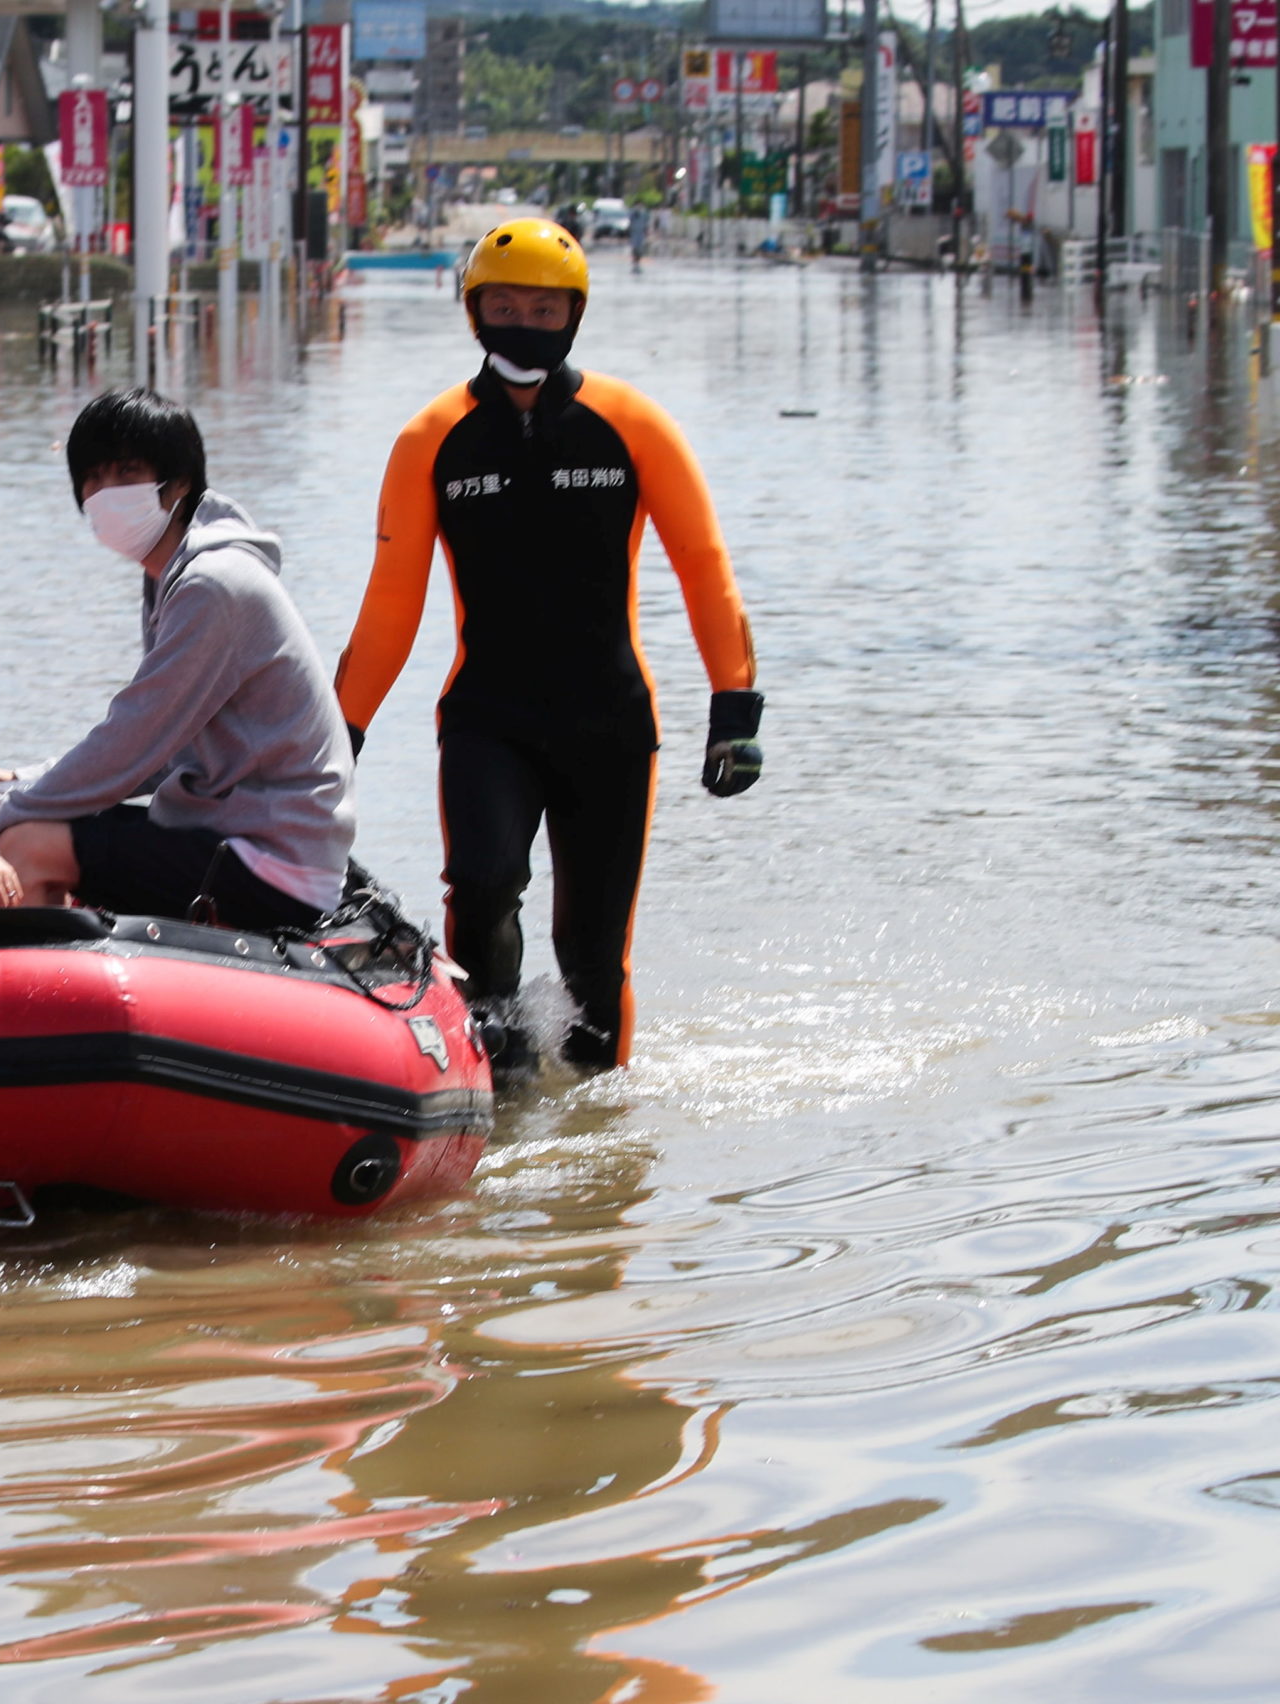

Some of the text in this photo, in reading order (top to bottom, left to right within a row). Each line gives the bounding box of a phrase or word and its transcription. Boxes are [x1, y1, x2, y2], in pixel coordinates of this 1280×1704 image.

[171, 43, 270, 94] うどん
[551, 467, 626, 490] 有田消防
